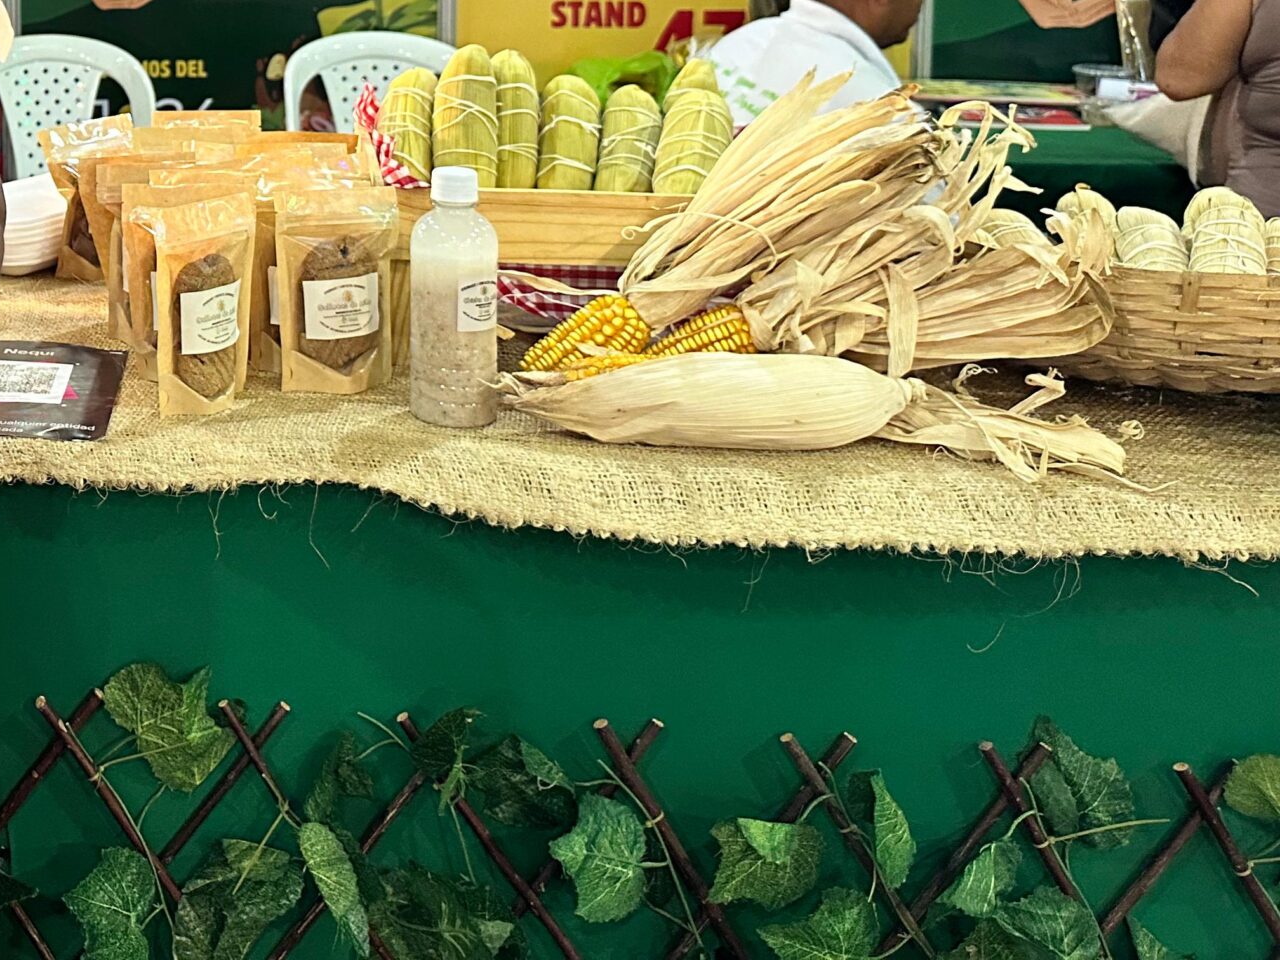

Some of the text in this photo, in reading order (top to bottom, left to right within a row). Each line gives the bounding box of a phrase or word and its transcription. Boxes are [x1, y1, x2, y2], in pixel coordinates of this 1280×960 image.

[550, 0, 646, 28] STAND
[175, 59, 208, 78] DEL
[3, 348, 55, 358] Nequi
